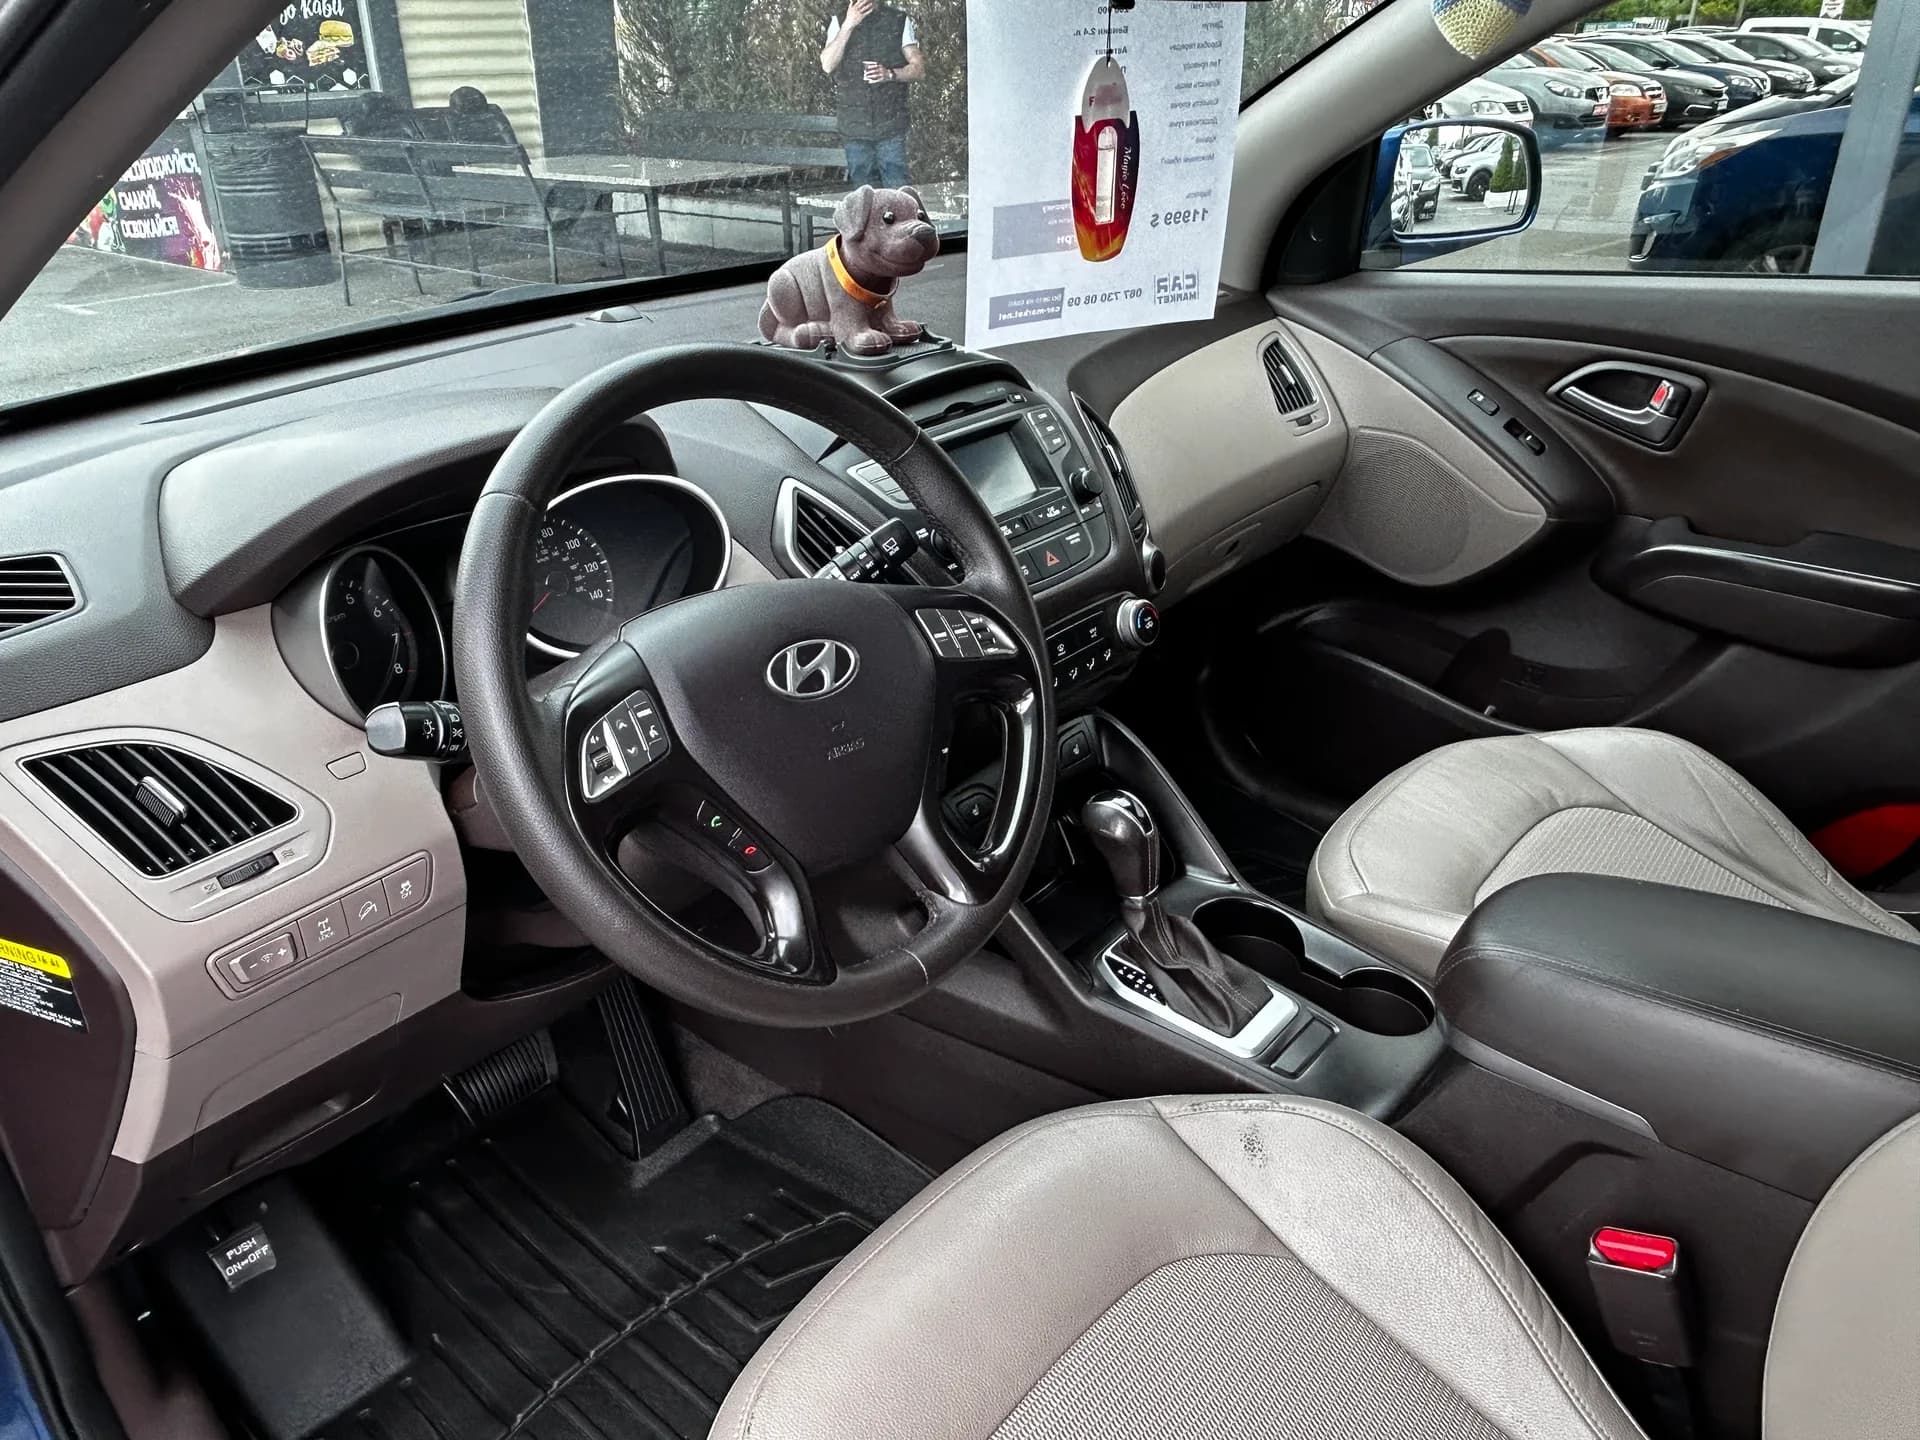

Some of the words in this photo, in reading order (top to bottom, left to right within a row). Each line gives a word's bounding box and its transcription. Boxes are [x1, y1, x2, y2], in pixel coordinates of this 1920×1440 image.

[540, 527, 554, 538] 80
[565, 538, 580, 550] 100
[584, 561, 598, 573] 120
[346, 594, 355, 604] 5
[589, 588, 603, 600] 140
[373, 608, 382, 618] 6
[392, 632, 400, 645] 7
[394, 663, 404, 674] 8
[226, 1237, 257, 1260] PUSH
